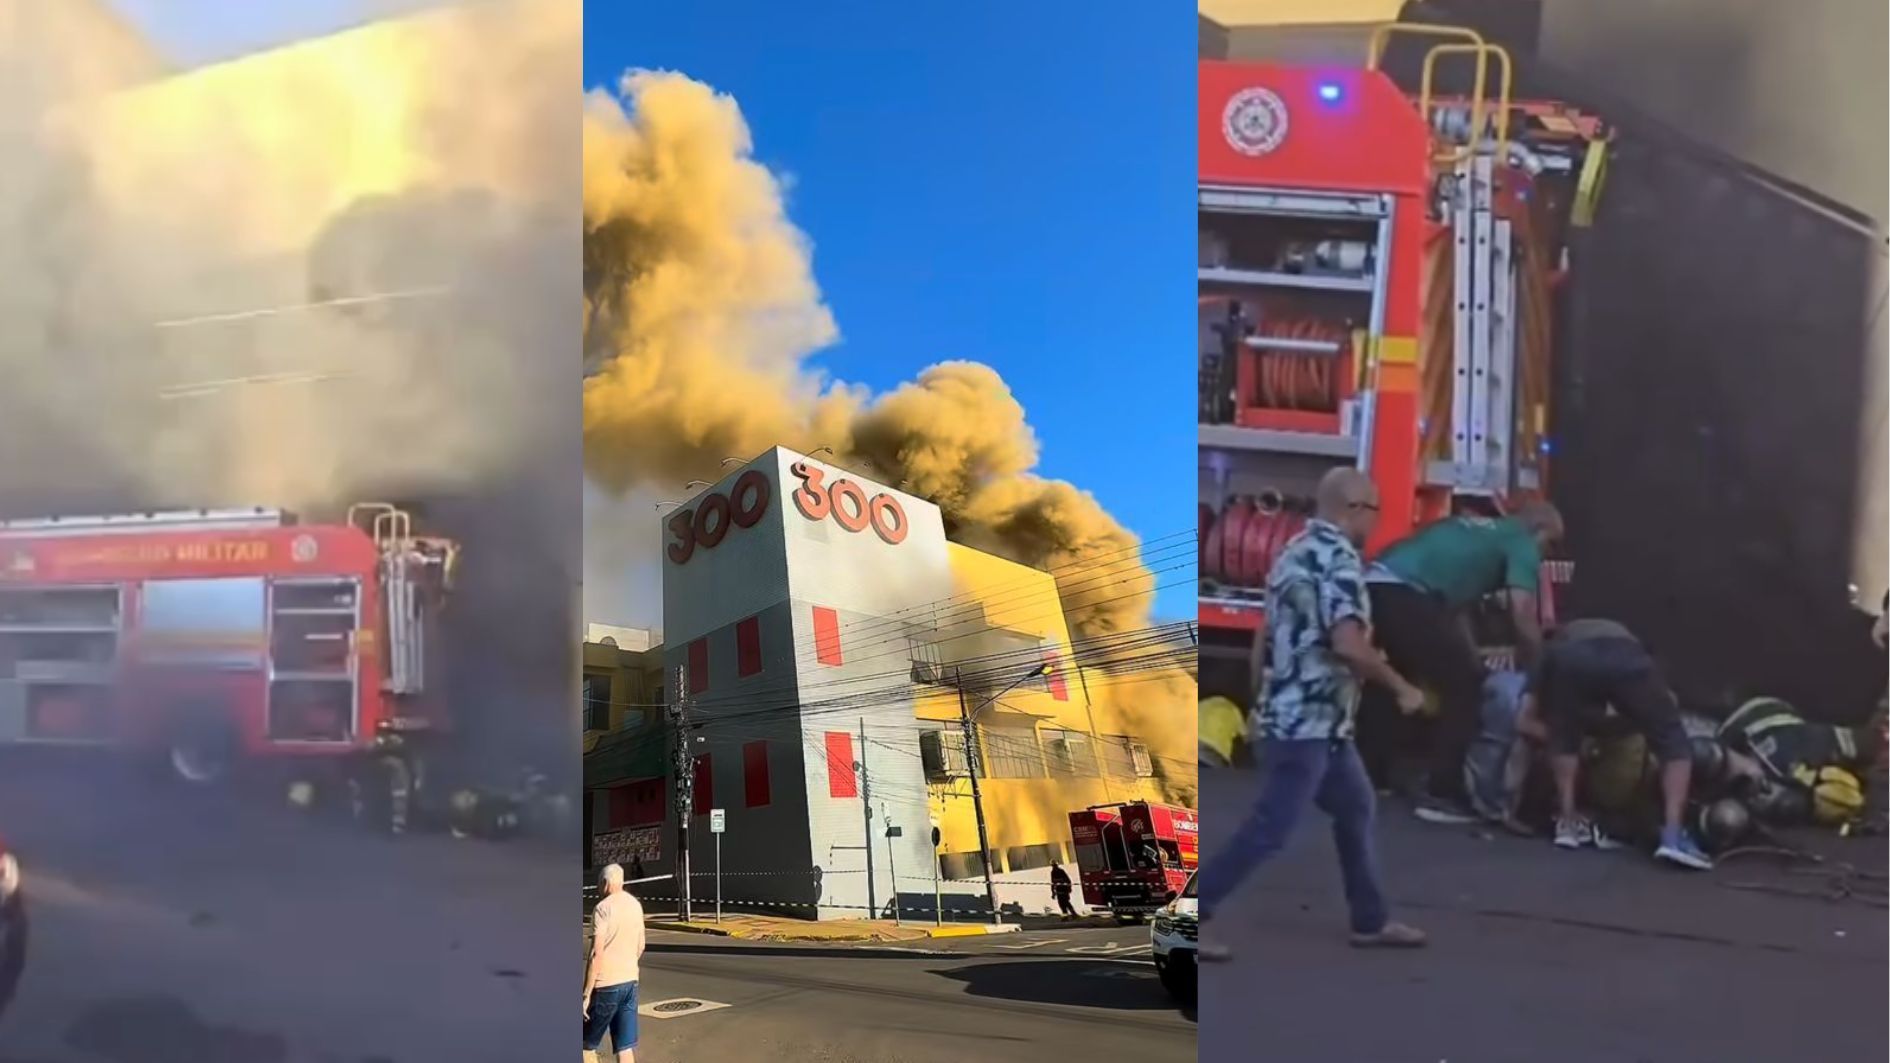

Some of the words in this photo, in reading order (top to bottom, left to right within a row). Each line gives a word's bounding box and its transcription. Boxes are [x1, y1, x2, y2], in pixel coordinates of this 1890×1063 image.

[668, 469, 771, 564] 300
[790, 462, 908, 545] 300
[176, 541, 268, 561] MILITAR
